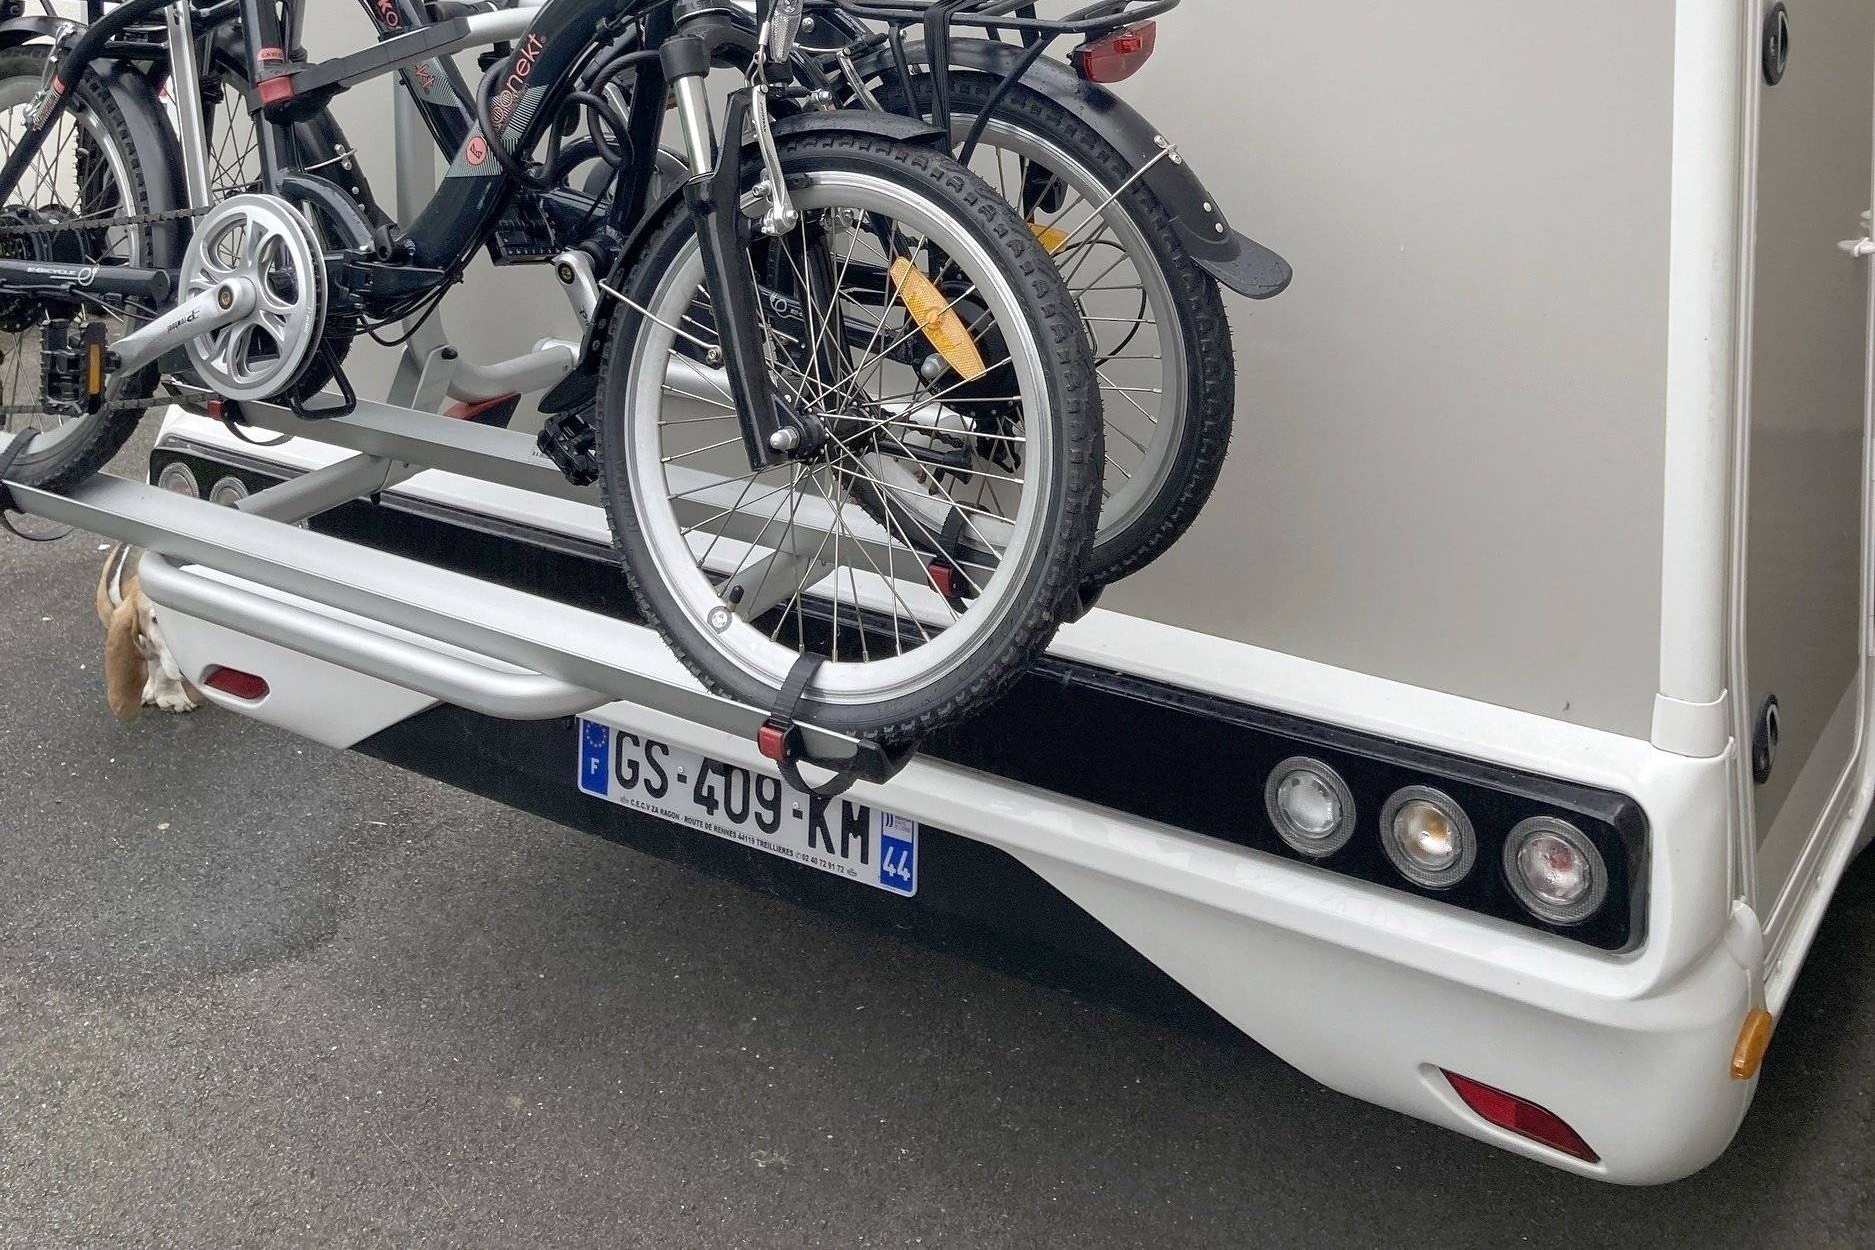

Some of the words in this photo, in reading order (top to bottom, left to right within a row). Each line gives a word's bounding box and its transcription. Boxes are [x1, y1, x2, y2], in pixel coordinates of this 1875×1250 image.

[490, 33, 543, 129] oonekt
[590, 756, 600, 776] F
[615, 730, 871, 865] GS-409-KM
[684, 815, 704, 828] ROUTE
[704, 822, 713, 831] DE
[713, 825, 737, 839] RENNES
[882, 845, 911, 882] 44
